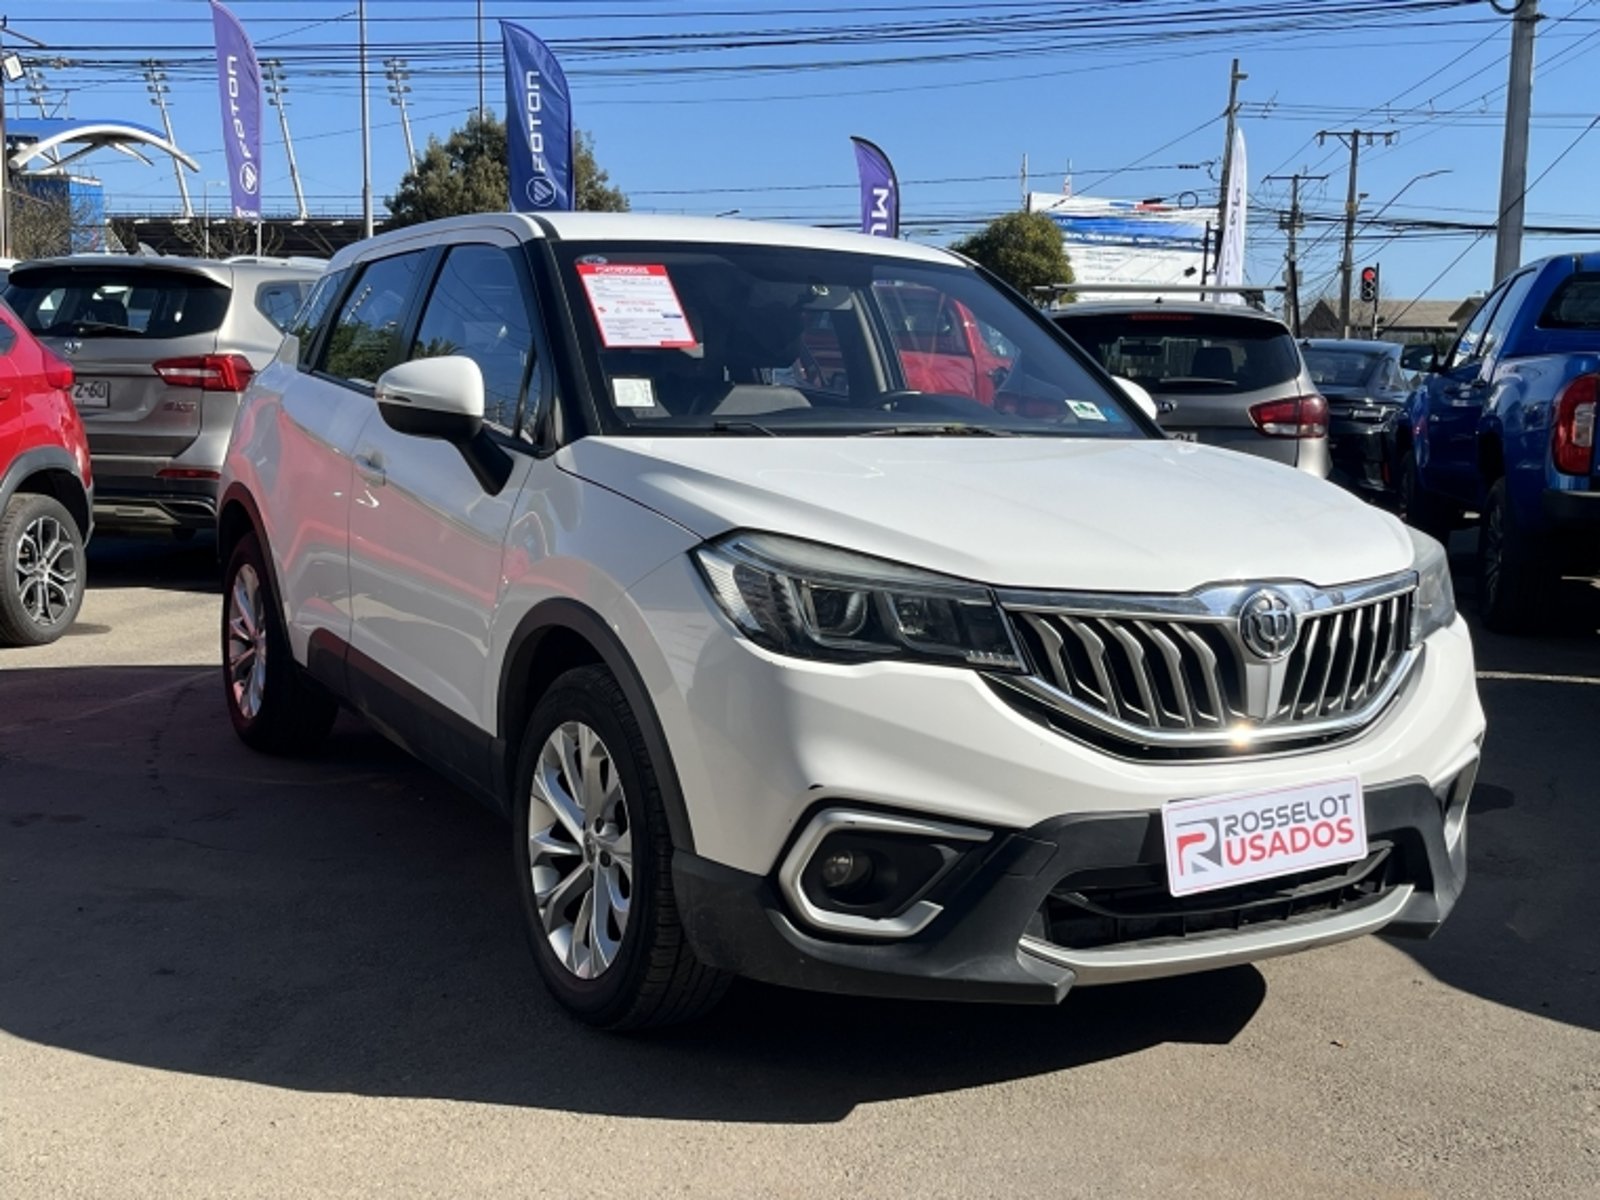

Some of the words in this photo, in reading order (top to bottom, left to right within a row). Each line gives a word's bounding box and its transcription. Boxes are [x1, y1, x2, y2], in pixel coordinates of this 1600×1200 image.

[525, 70, 546, 173] FOTON
[1223, 794, 1351, 837] ROSSELOT
[1225, 818, 1355, 865] USADOS
